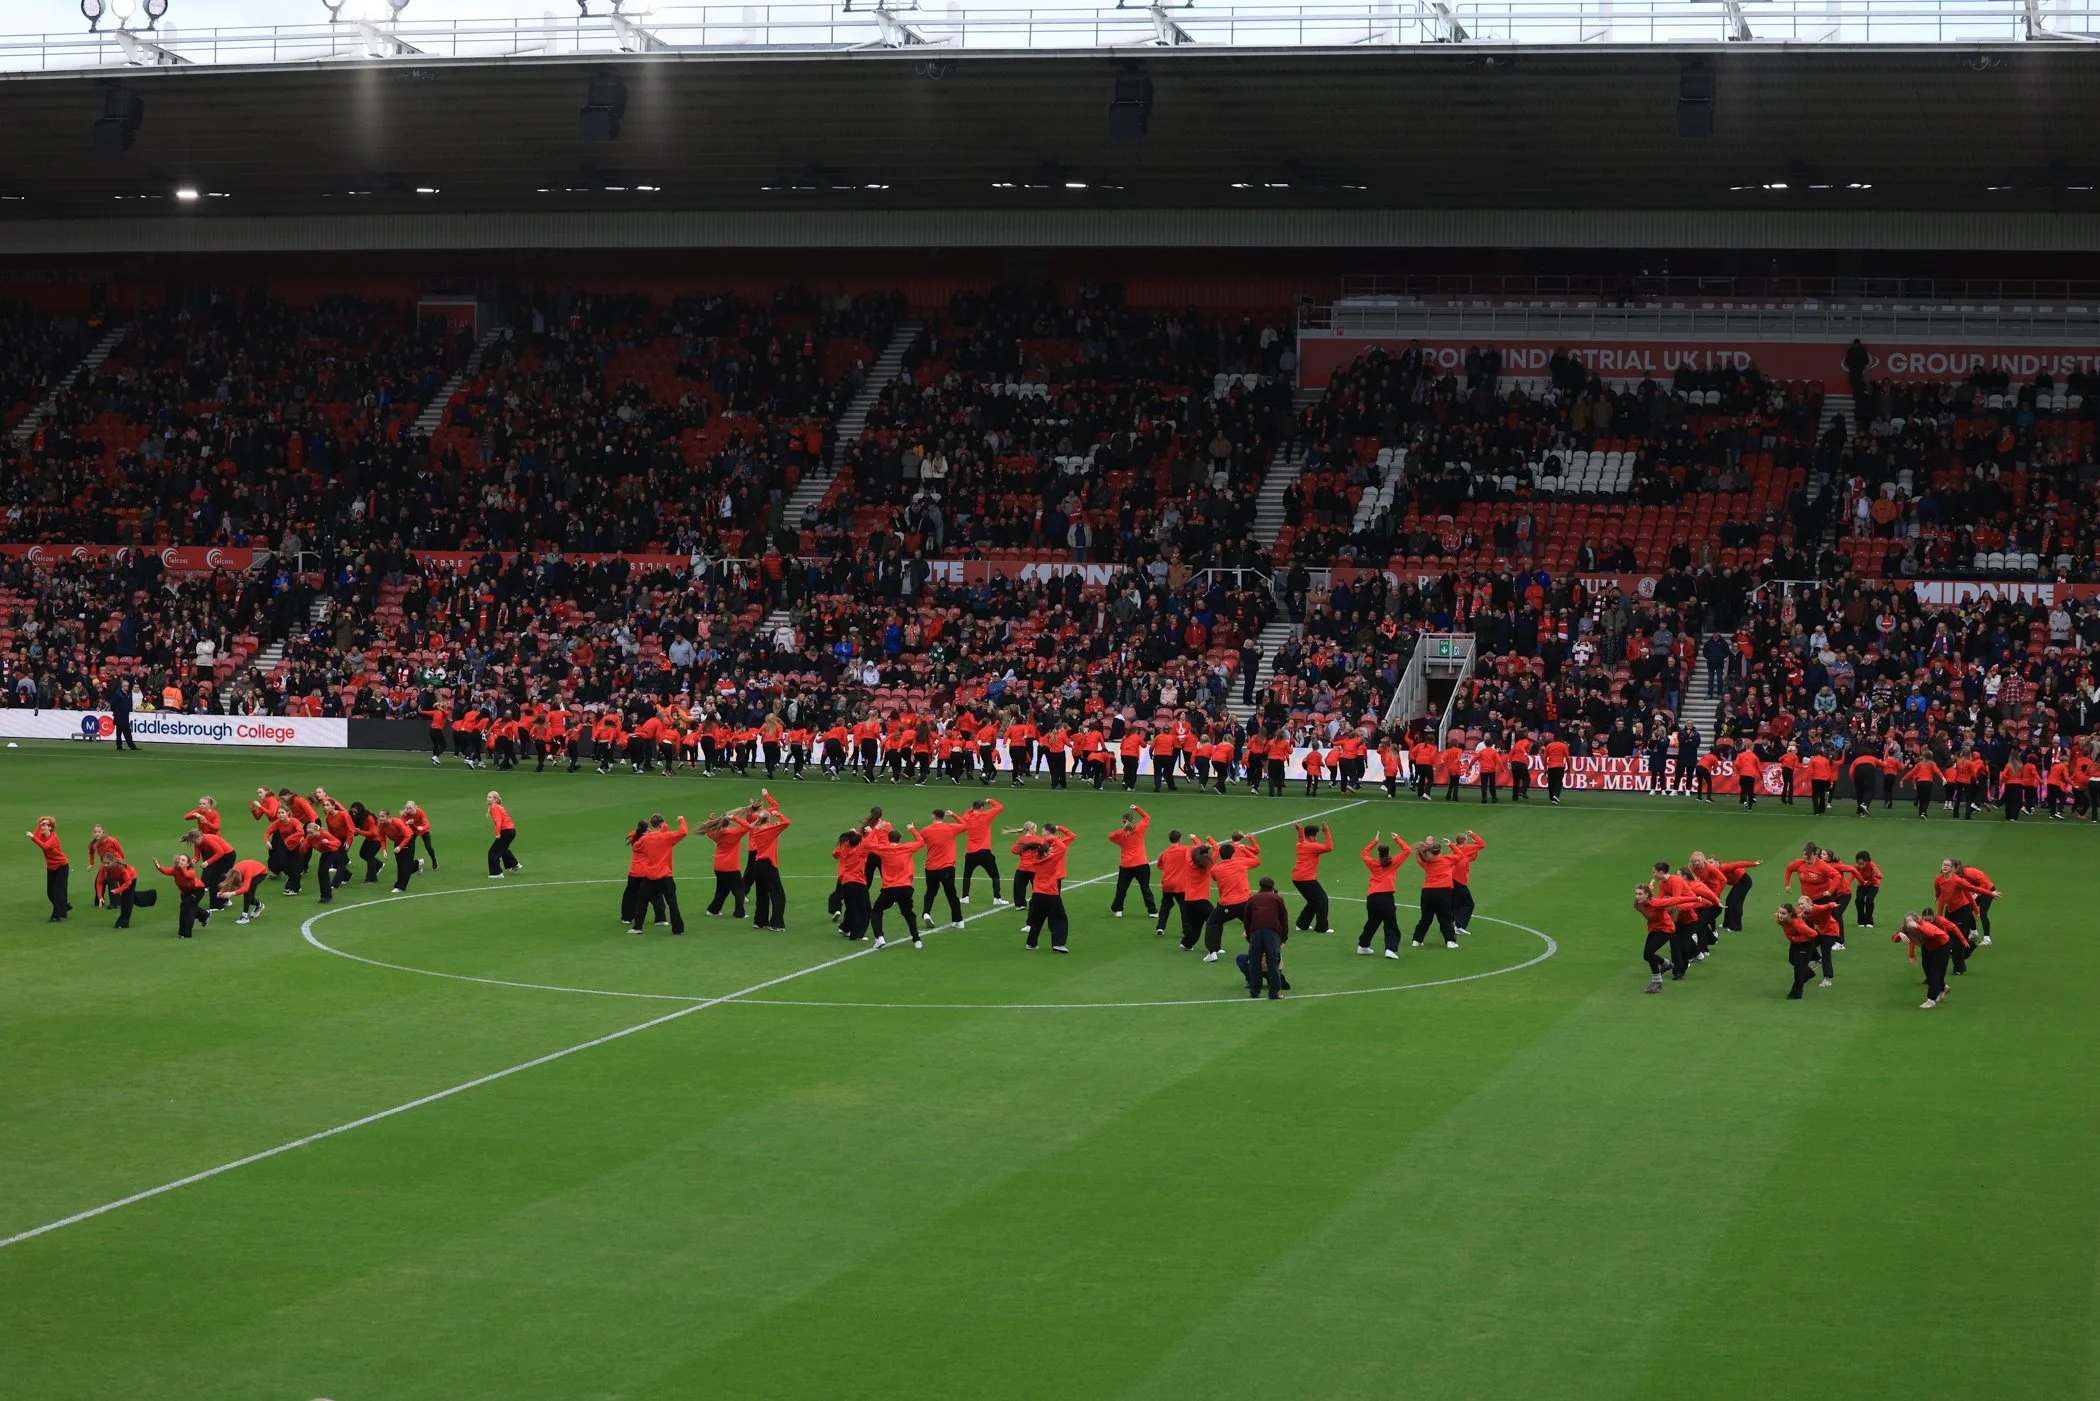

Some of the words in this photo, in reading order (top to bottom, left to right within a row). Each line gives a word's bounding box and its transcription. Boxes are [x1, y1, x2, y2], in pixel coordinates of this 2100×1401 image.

[1501, 348, 1656, 370] INDSTRIAL
[1663, 350, 1699, 371] UK
[1888, 353, 1985, 374] GROUP
[35, 554, 54, 562] Telcoss
[214, 557, 234, 565] Telcoss
[424, 559, 463, 567] TORE
[1914, 581, 2054, 606] MIDNITE
[86, 721, 95, 731] M
[102, 721, 109, 731] C
[236, 724, 295, 743] College
[1537, 773, 1598, 789] CUB+
